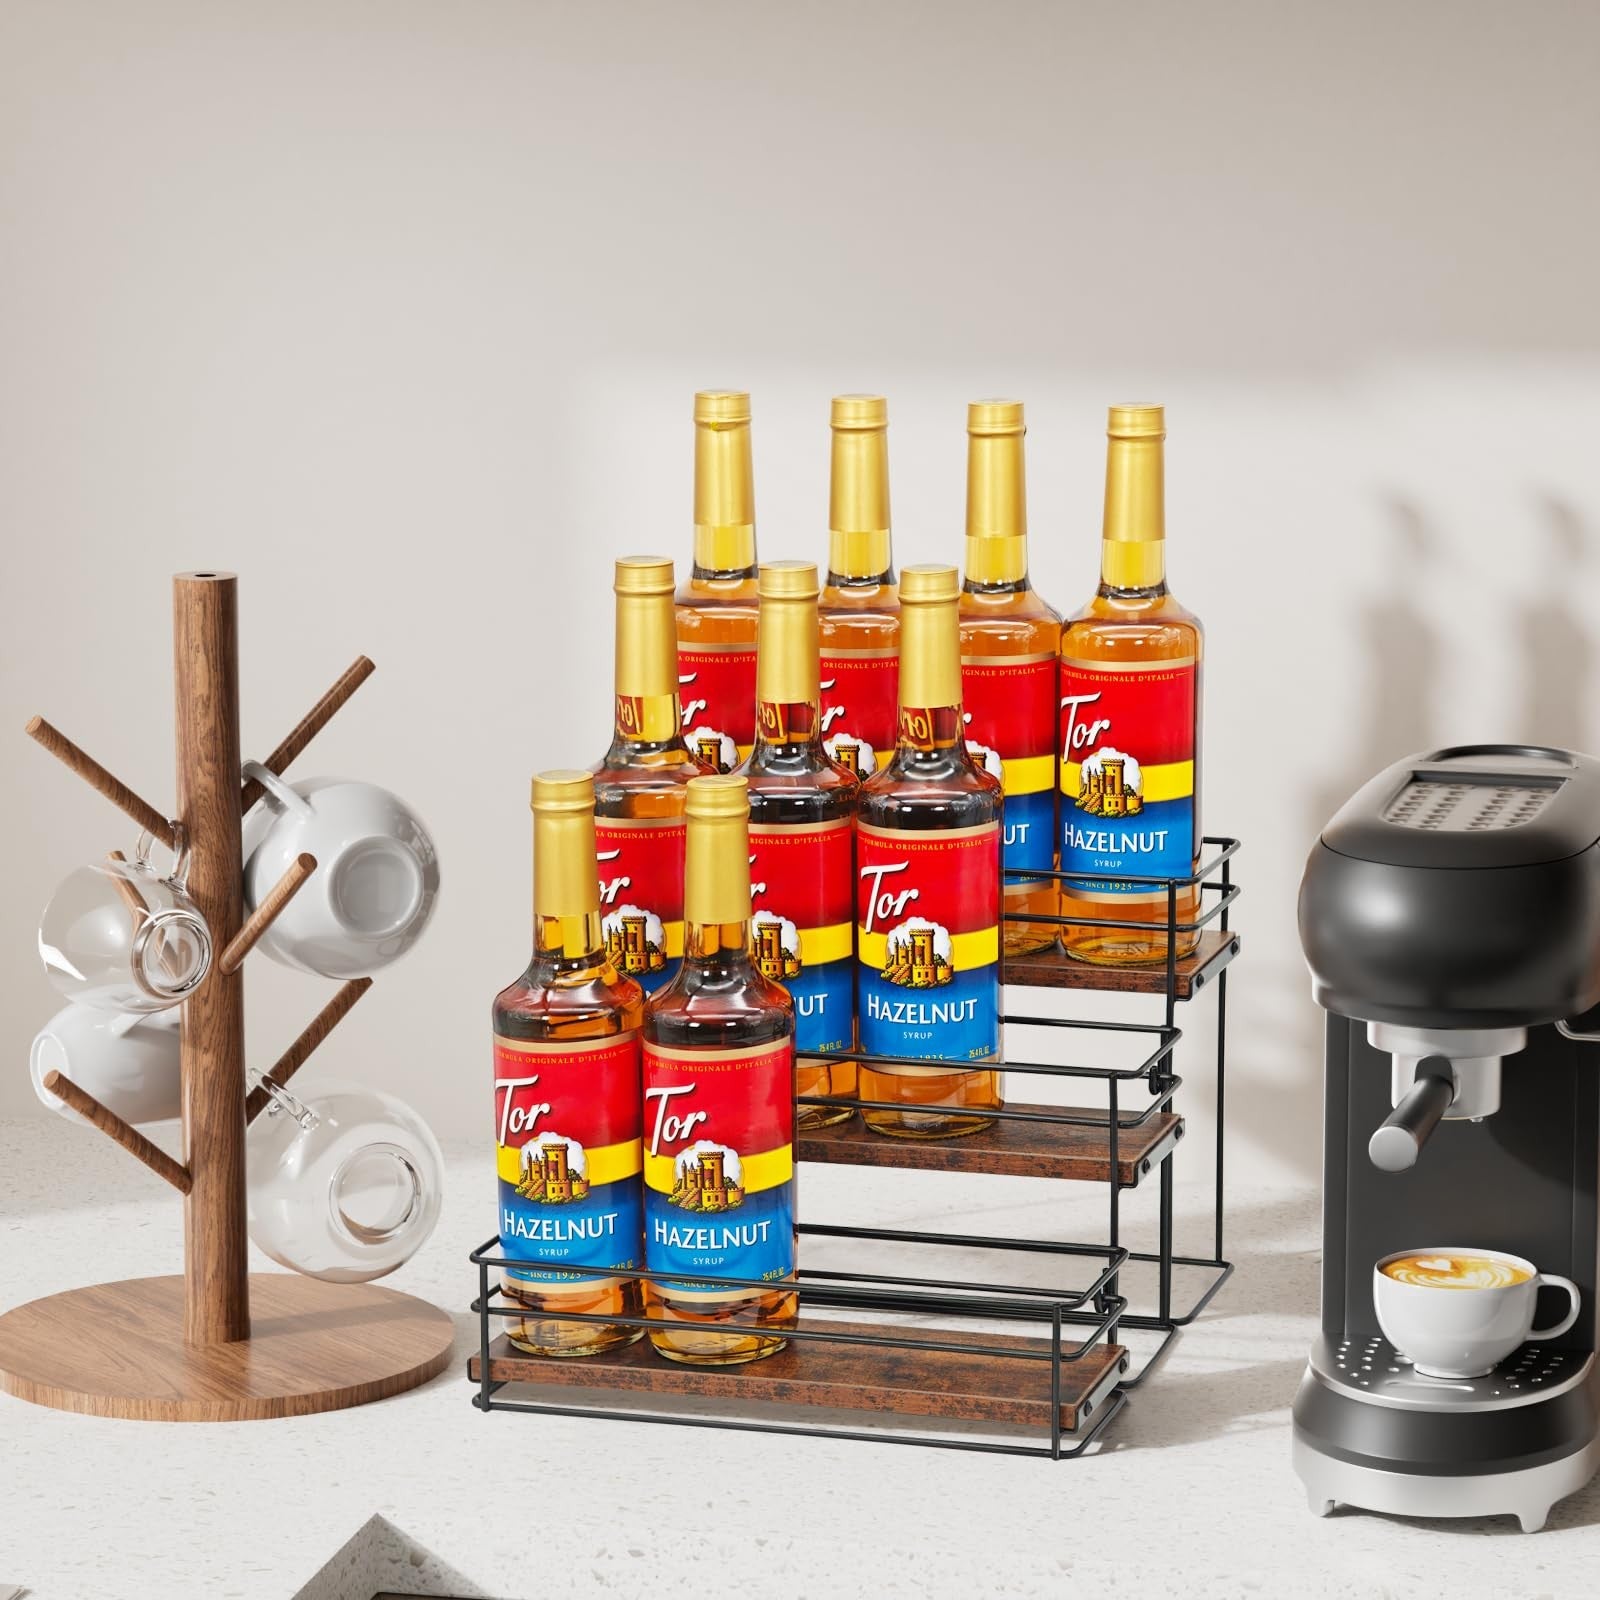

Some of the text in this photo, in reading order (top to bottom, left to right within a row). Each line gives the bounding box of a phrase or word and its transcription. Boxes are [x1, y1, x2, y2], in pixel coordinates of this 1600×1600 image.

[684, 655, 731, 663] ORIGINALE
[733, 655, 757, 663] D'ITA
[872, 661, 899, 669] D'ITAL
[962, 667, 1036, 676] IGINALE D'ITALIA
[1089, 674, 1136, 682] ORIGINALE
[1138, 673, 1175, 681] D'ITALIA
[1060, 691, 1111, 764] Tor
[607, 831, 653, 839] ORIGINALE
[658, 828, 686, 838] D'ITAL
[1064, 822, 1168, 853] HAZELNUT
[749, 835, 832, 845] RIGINALE D'ITALIA
[895, 843, 945, 851] ORIGINALE
[947, 839, 983, 849] D'ITALIA
[1094, 859, 1122, 868] SYRUP
[1109, 881, 1132, 891] 1925
[860, 860, 919, 934] Tor
[868, 993, 978, 1024] HAZELNUT
[903, 1031, 933, 1040] SYRUP
[525, 1056, 575, 1064] ORIGINALE
[578, 1051, 618, 1063] D'ITALIA
[681, 1064, 732, 1073] ORIGINALE
[735, 1058, 773, 1070] D'ITALIA
[495, 1074, 550, 1149] Tor
[645, 1082, 707, 1158] Tor
[503, 1209, 618, 1241] HAZELNUT
[655, 1218, 771, 1250] HAZELNUT
[539, 1248, 569, 1257] SYRUP
[693, 1257, 724, 1265] SYRUP
